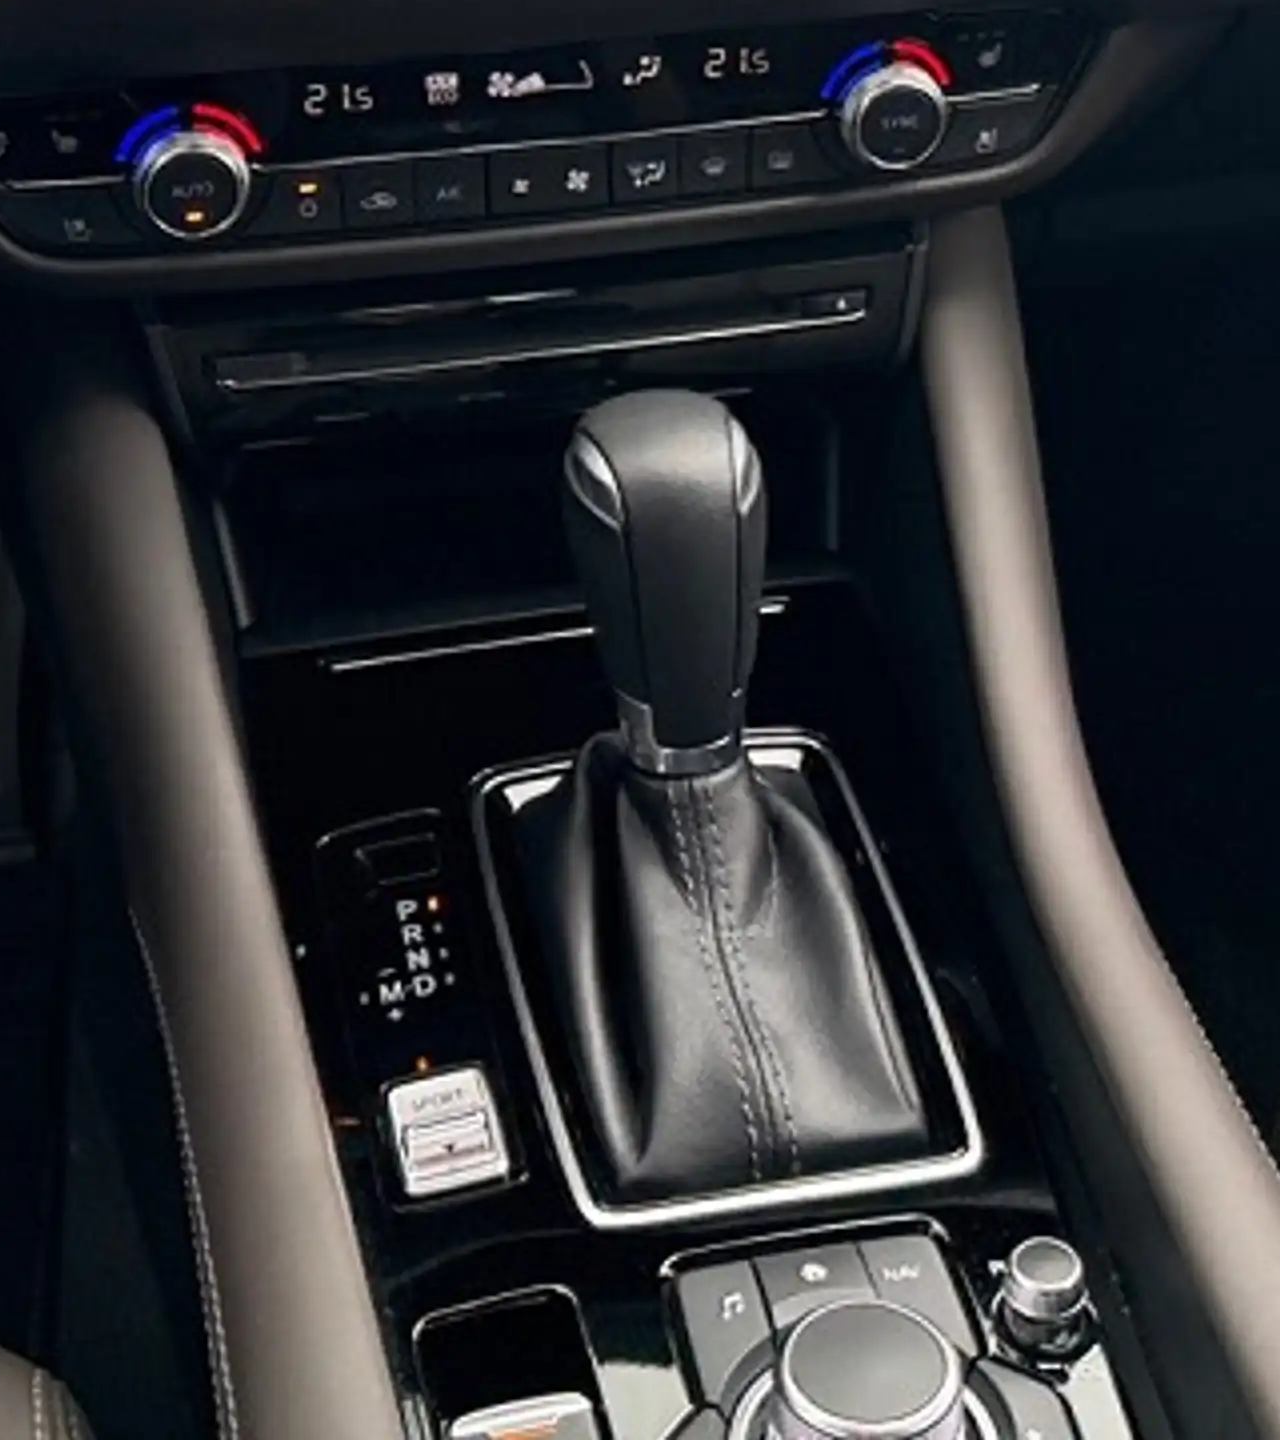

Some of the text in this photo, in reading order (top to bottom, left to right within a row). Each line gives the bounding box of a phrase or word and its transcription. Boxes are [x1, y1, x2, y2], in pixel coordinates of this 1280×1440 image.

[396, 899, 418, 922] P
[401, 923, 424, 946] R
[406, 947, 431, 972] N
[378, 973, 437, 1005] M D
